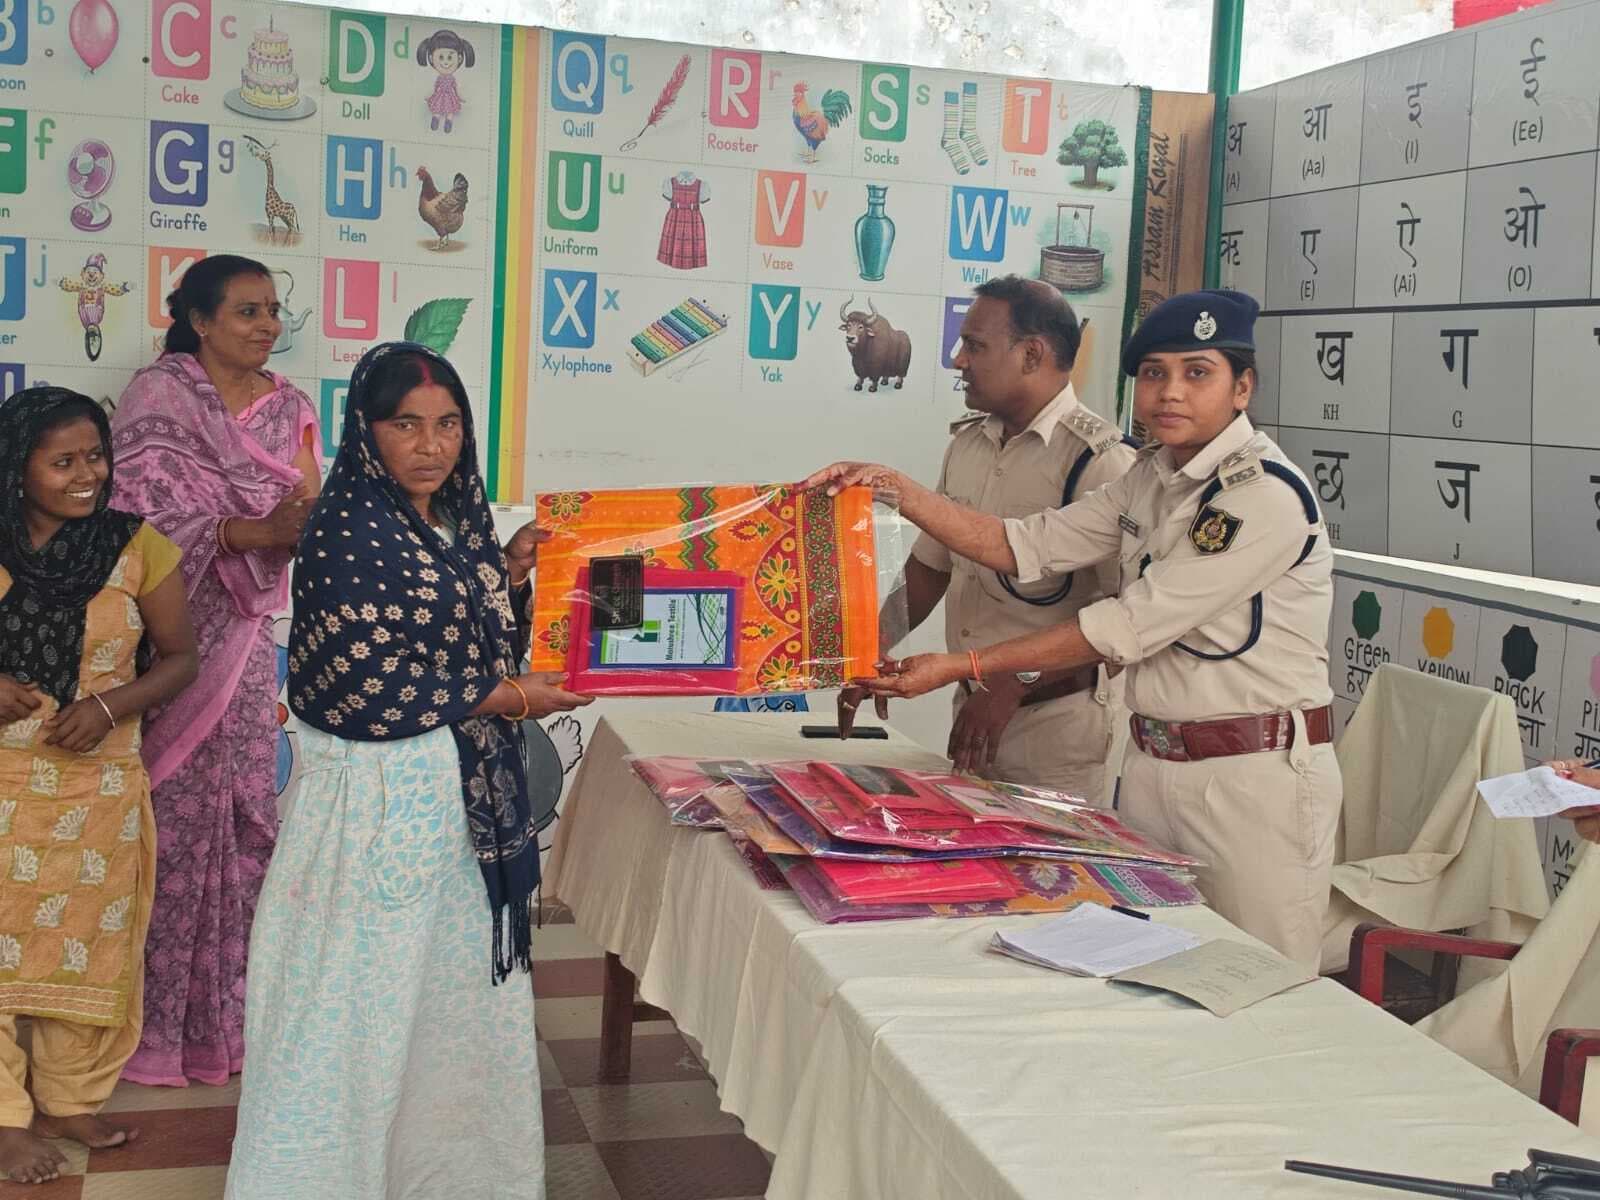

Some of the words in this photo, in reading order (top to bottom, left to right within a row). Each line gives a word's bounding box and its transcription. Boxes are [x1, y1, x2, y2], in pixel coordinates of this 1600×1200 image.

[38, 0, 55, 25] b
[161, 2, 200, 67] C
[338, 19, 375, 83] D
[393, 26, 409, 59] d
[557, 41, 599, 108] Q
[610, 54, 634, 94] q
[720, 57, 752, 119] R
[769, 69, 782, 90] r
[1520, 37, 1546, 106] ई
[161, 85, 200, 105] Cake
[342, 101, 370, 120] Doll
[868, 73, 899, 130] S
[916, 84, 930, 105] s
[563, 120, 594, 139] Quill
[1015, 87, 1042, 144] T
[1057, 94, 1069, 121] t
[1303, 104, 1332, 142] आ
[1513, 116, 1543, 147] (Ee)
[34, 117, 56, 160] f
[707, 133, 759, 153] Rooster
[863, 147, 899, 165] Socks
[1228, 122, 1247, 155] अ
[155, 129, 202, 195] G
[218, 139, 235, 174] g
[336, 144, 373, 209] H
[389, 147, 407, 188] h
[1010, 160, 1037, 177] Tree
[1145, 132, 1175, 199] Royal
[1226, 171, 1240, 193] (A)
[1302, 157, 1325, 180] (Aa)
[558, 159, 591, 220] U
[608, 172, 625, 194] u
[764, 176, 800, 236] V
[149, 211, 207, 232] Giraffe
[339, 224, 367, 243] Hen
[957, 193, 1004, 252] W
[1397, 202, 1421, 267] ऐ
[1504, 187, 1545, 248] ओ
[33, 244, 47, 288] j
[544, 237, 598, 256] Uniform
[763, 253, 793, 271] Vase
[1301, 229, 1321, 274] ए
[962, 267, 988, 283] Well
[1300, 280, 1315, 302] (E)
[1393, 273, 1417, 297] (Ai)
[336, 267, 366, 329] L
[550, 277, 587, 338] X
[602, 288, 620, 311] x
[759, 291, 793, 349] Y
[806, 301, 821, 331] y
[542, 353, 612, 378] Xylophone
[761, 366, 783, 384] Yak
[1315, 331, 1353, 385] ख
[1440, 329, 1479, 390] ग
[1323, 404, 1339, 420] KH
[1452, 410, 1463, 428] G
[1435, 461, 1480, 523] ज
[1453, 543, 1461, 560] J
